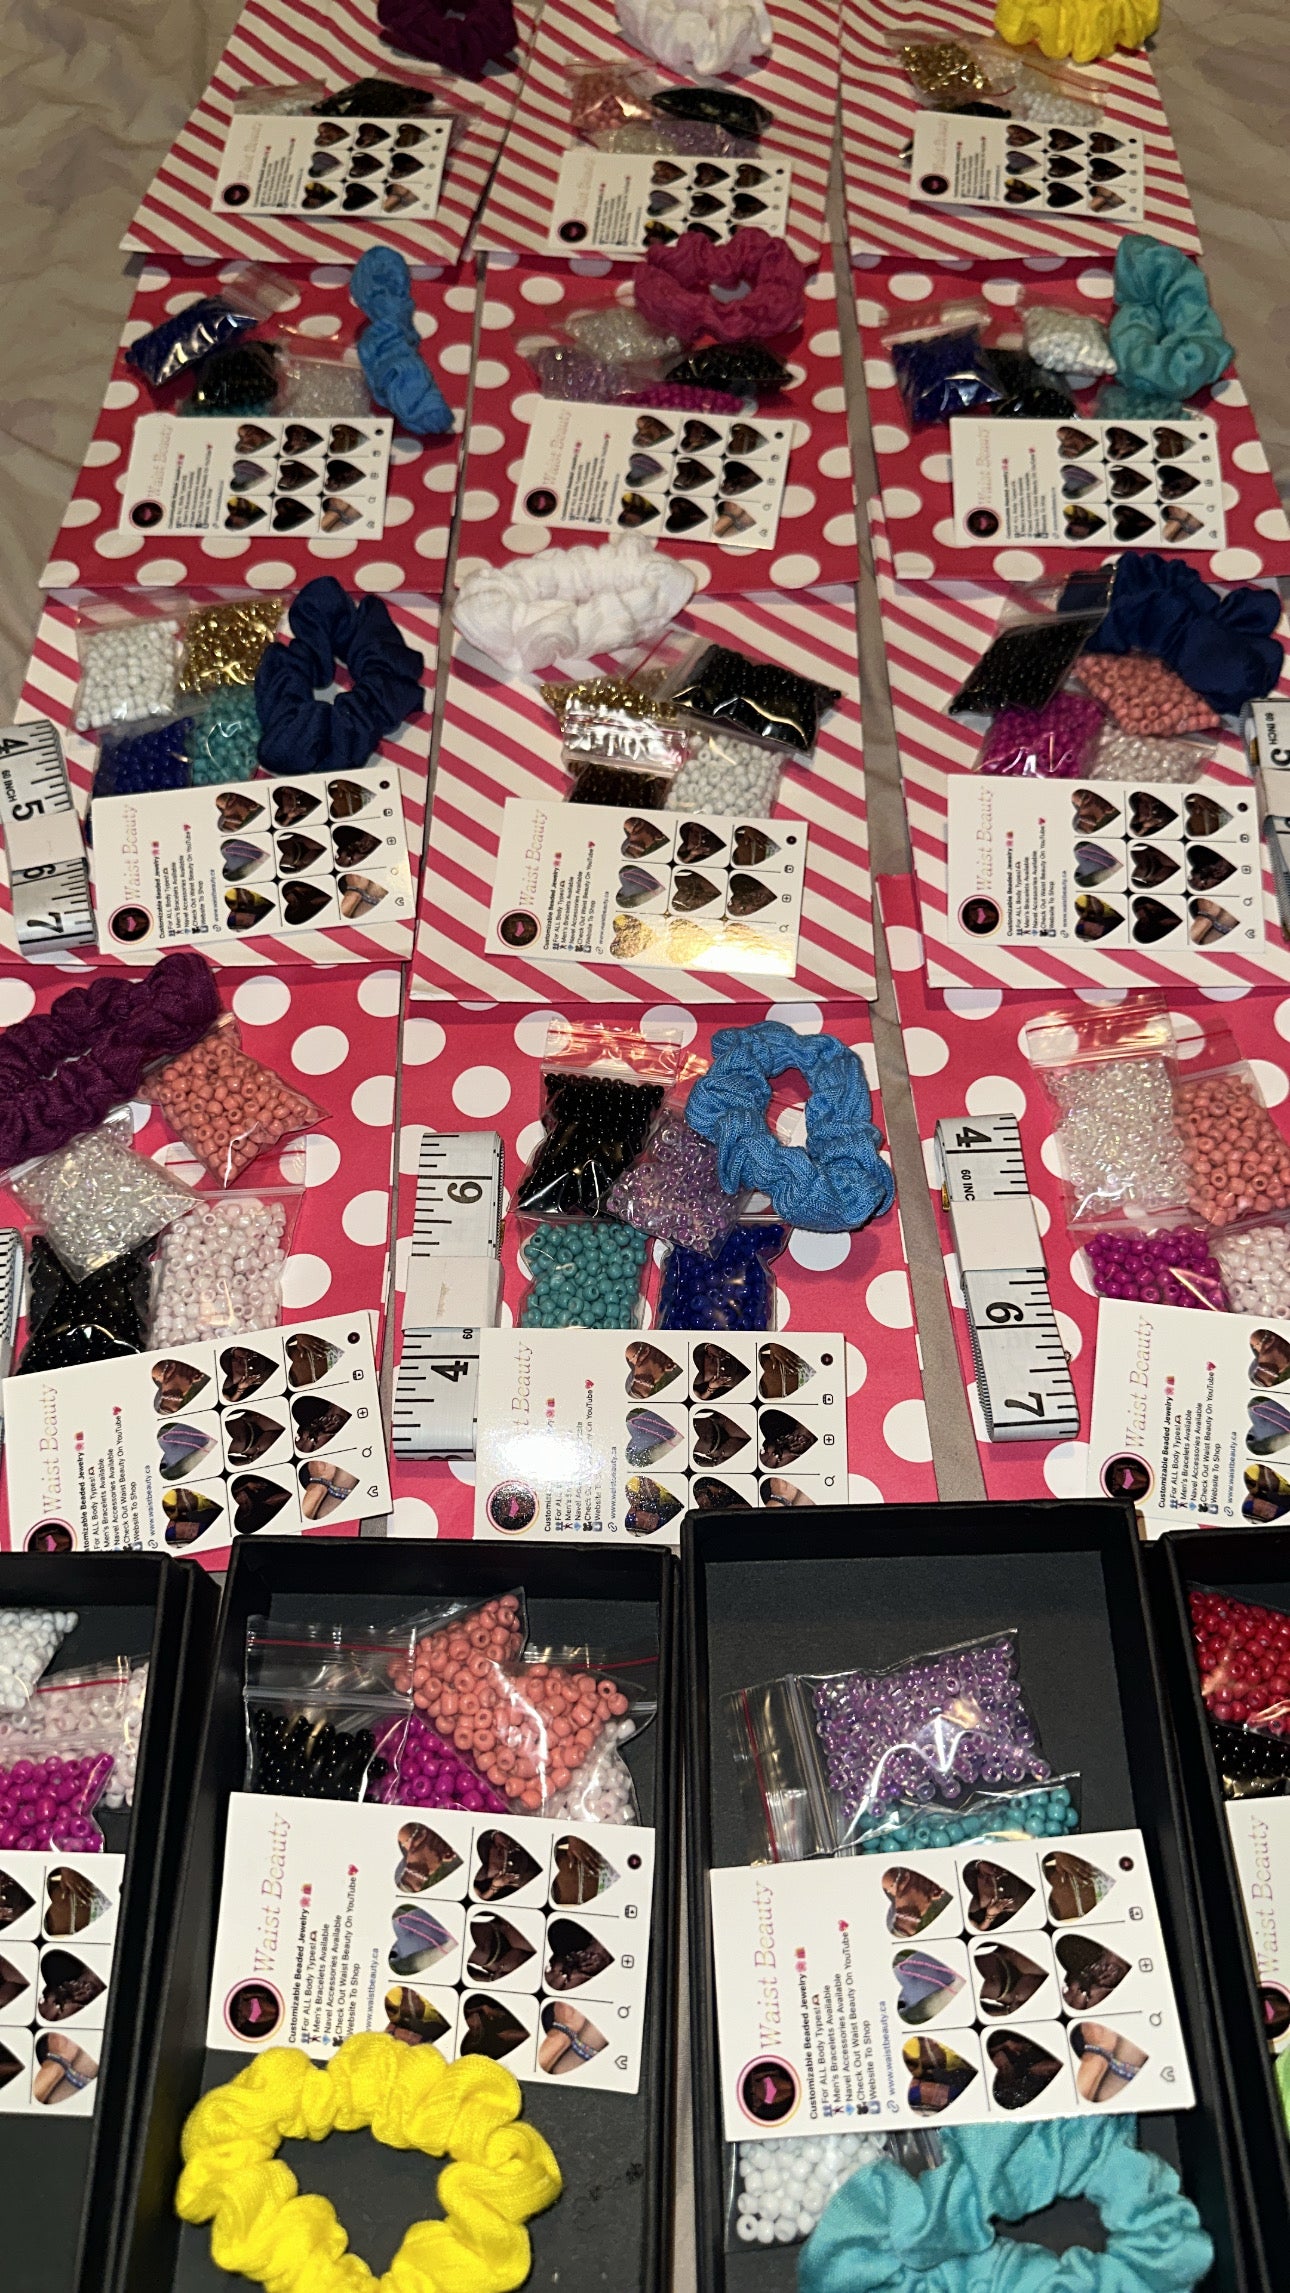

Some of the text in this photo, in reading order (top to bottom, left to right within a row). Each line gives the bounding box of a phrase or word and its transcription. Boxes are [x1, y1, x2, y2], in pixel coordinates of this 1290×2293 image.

[0, 739, 28, 755] 4
[1266, 723, 1278, 745] INCH
[4, 779, 17, 802] INCH
[12, 800, 45, 821] 5
[24, 864, 56, 879] 6
[122, 804, 141, 901] Waist Beauty
[518, 809, 548, 905] Waist Beauty
[976, 786, 994, 891] Waist Beauty
[27, 912, 64, 933] 7
[956, 1127, 992, 1148] 4
[961, 1169, 976, 1201] 60 INC
[462, 1328, 473, 1340] 60
[986, 1302, 1024, 1323] 6
[430, 1360, 469, 1383] 4
[511, 1342, 533, 1413] Beauty
[585, 1389, 593, 1419] YouTube
[1004, 1391, 1045, 1418] 7
[1125, 1316, 1154, 1447] Waist Beauty
[39, 1384, 62, 1514] Waist Beauty
[114, 1415, 131, 1543] Check Out Waist Beauty On YouTube
[1158, 1396, 1174, 1508] Customizable Beaded Jewelry
[1169, 1424, 1182, 1499] For ALL Body Types!
[1179, 1409, 1192, 1500] Men's Bracelets Available
[1189, 1402, 1203, 1501] Navel Accessories Available
[1199, 1371, 1215, 1502] Check Out Waist Beauty On YouTube
[1210, 1442, 1222, 1503] Website To Shop
[1227, 1431, 1237, 1503] www.waistbeauty.ca
[76, 1452, 90, 1553] stomizable Beaded Jewelry
[88, 1475, 98, 1500] Types!
[90, 1501, 99, 1520] Body
[91, 1520, 99, 1535] ALL
[97, 1458, 110, 1547] Men's Bracelets Available
[106, 1448, 120, 1545] Navel Accessories Available
[129, 1481, 140, 1541] Website To Shop
[144, 1465, 155, 1536] www.waistbeauty.ca
[554, 1508, 562, 1521] For
[253, 1813, 291, 1971] Waist Beauty
[1248, 1815, 1279, 1974] Waist Beauty
[287, 1908, 309, 2044] Customizable Beaded Jewelry
[300, 1942, 317, 2032] For ALL Body Types!
[312, 1923, 330, 2033] Men's Bracelets Available
[323, 1914, 342, 2034] Navel Accessories Available
[334, 1876, 356, 2035] Check Out Waist Beauty On YouTube
[345, 1962, 361, 2035] Website To Shop
[754, 1882, 781, 2048] Waist Beauty
[798, 1973, 818, 2120] Customizable Beaded Jewelry
[813, 2006, 829, 2104] For ALL Body Types!
[823, 1984, 841, 2103] Men's Bracelets Available
[833, 1973, 853, 2102] Navel Accessories Available
[841, 1931, 866, 2101] Check Out Waist Beauty On YouTube
[862, 2019, 877, 2100] Website To Shop
[879, 2000, 895, 2095] www.waistbeauty.ca
